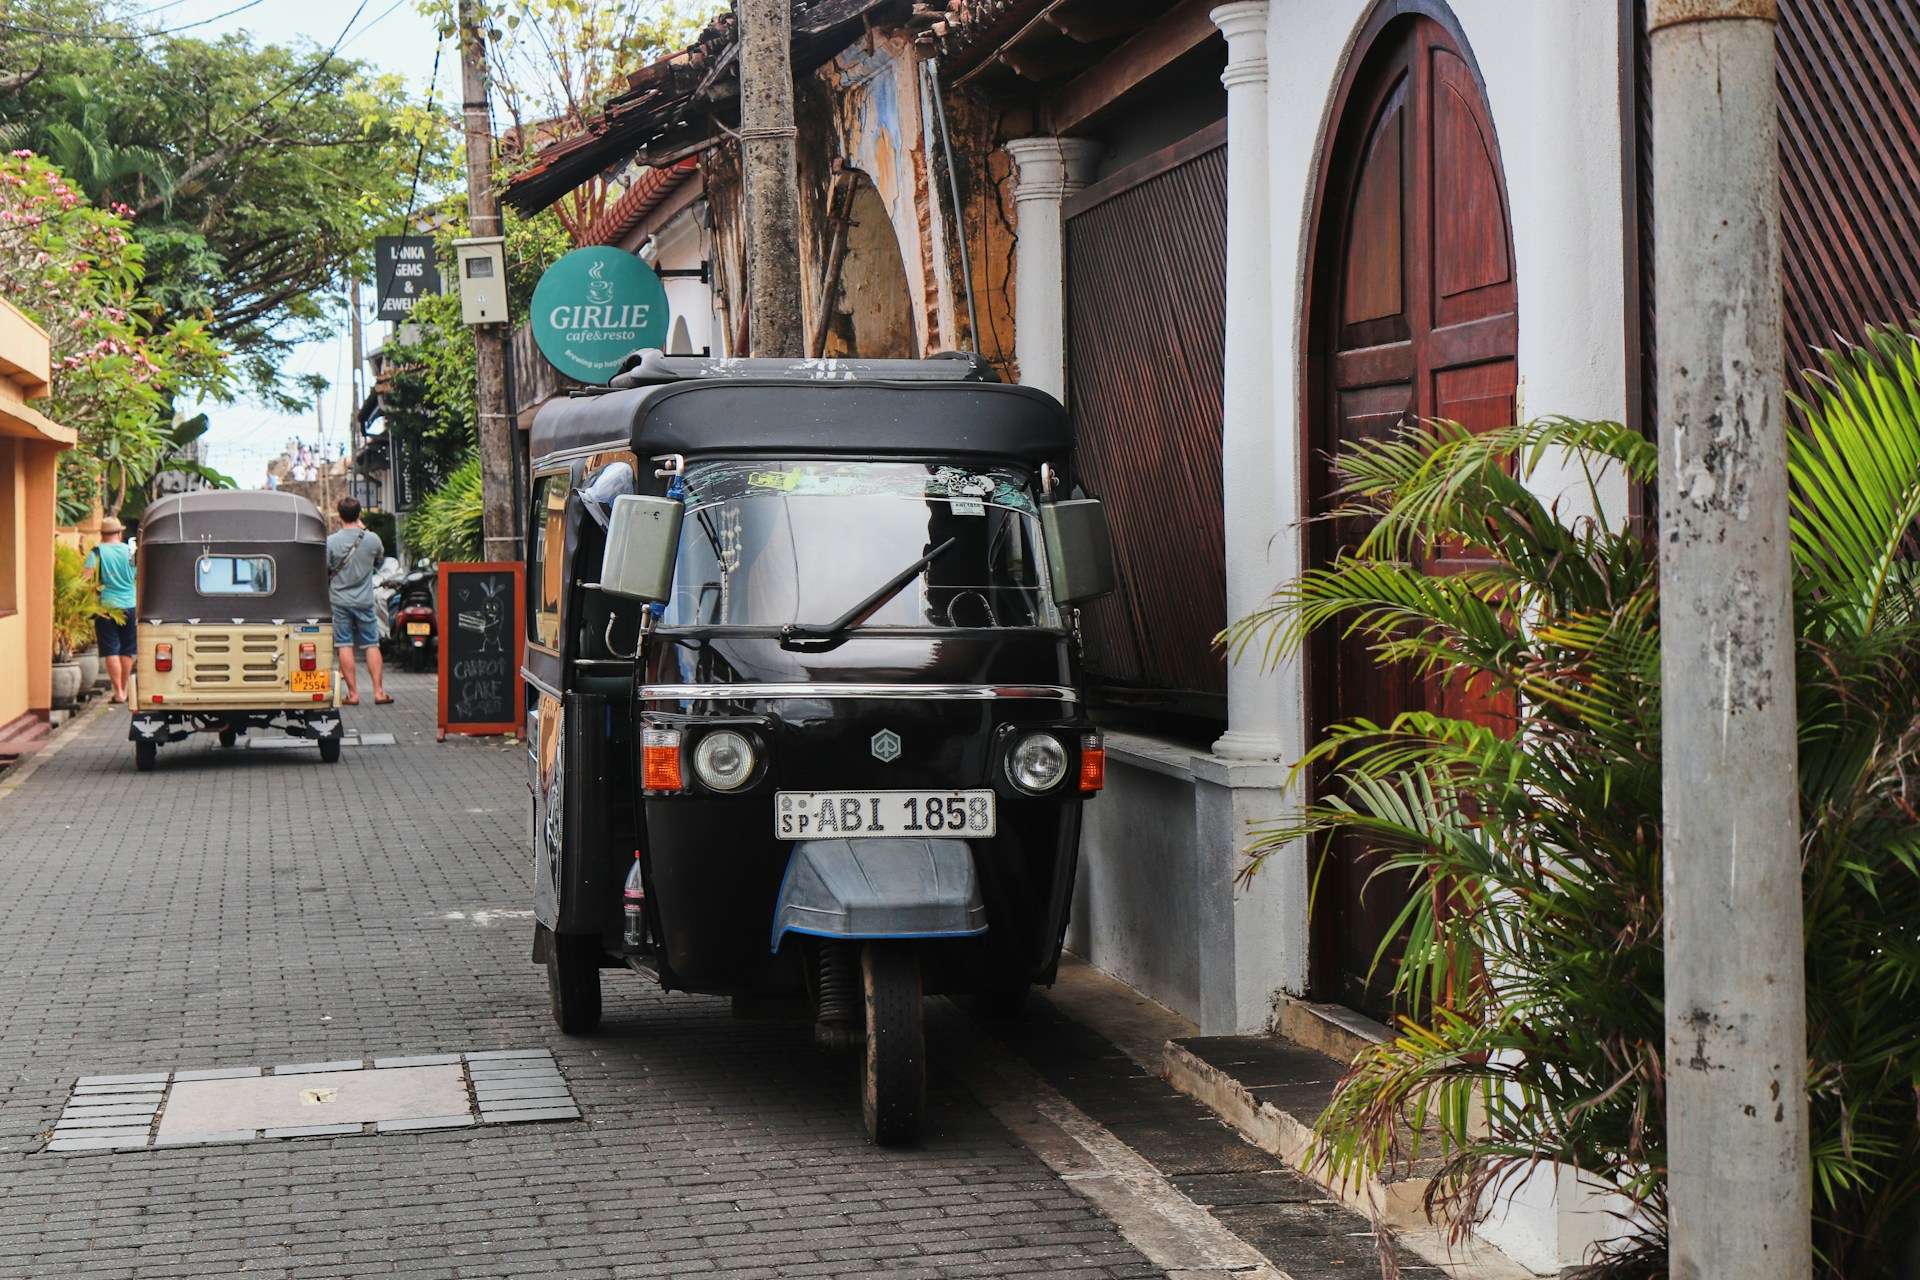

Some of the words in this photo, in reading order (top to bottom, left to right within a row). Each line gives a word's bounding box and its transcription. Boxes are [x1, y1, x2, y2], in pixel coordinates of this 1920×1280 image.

[395, 263, 423, 277] GEMS
[404, 280, 414, 293] &
[549, 304, 650, 330] GIRLIE
[566, 330, 635, 343] cafe&resto
[564, 348, 593, 369] Brewing
[593, 362, 604, 370] up
[453, 657, 506, 679] CARROT
[303, 681, 326, 690] 2554
[462, 680, 502, 700] CAKE
[817, 797, 885, 832] ABI
[903, 797, 989, 831] 1858
